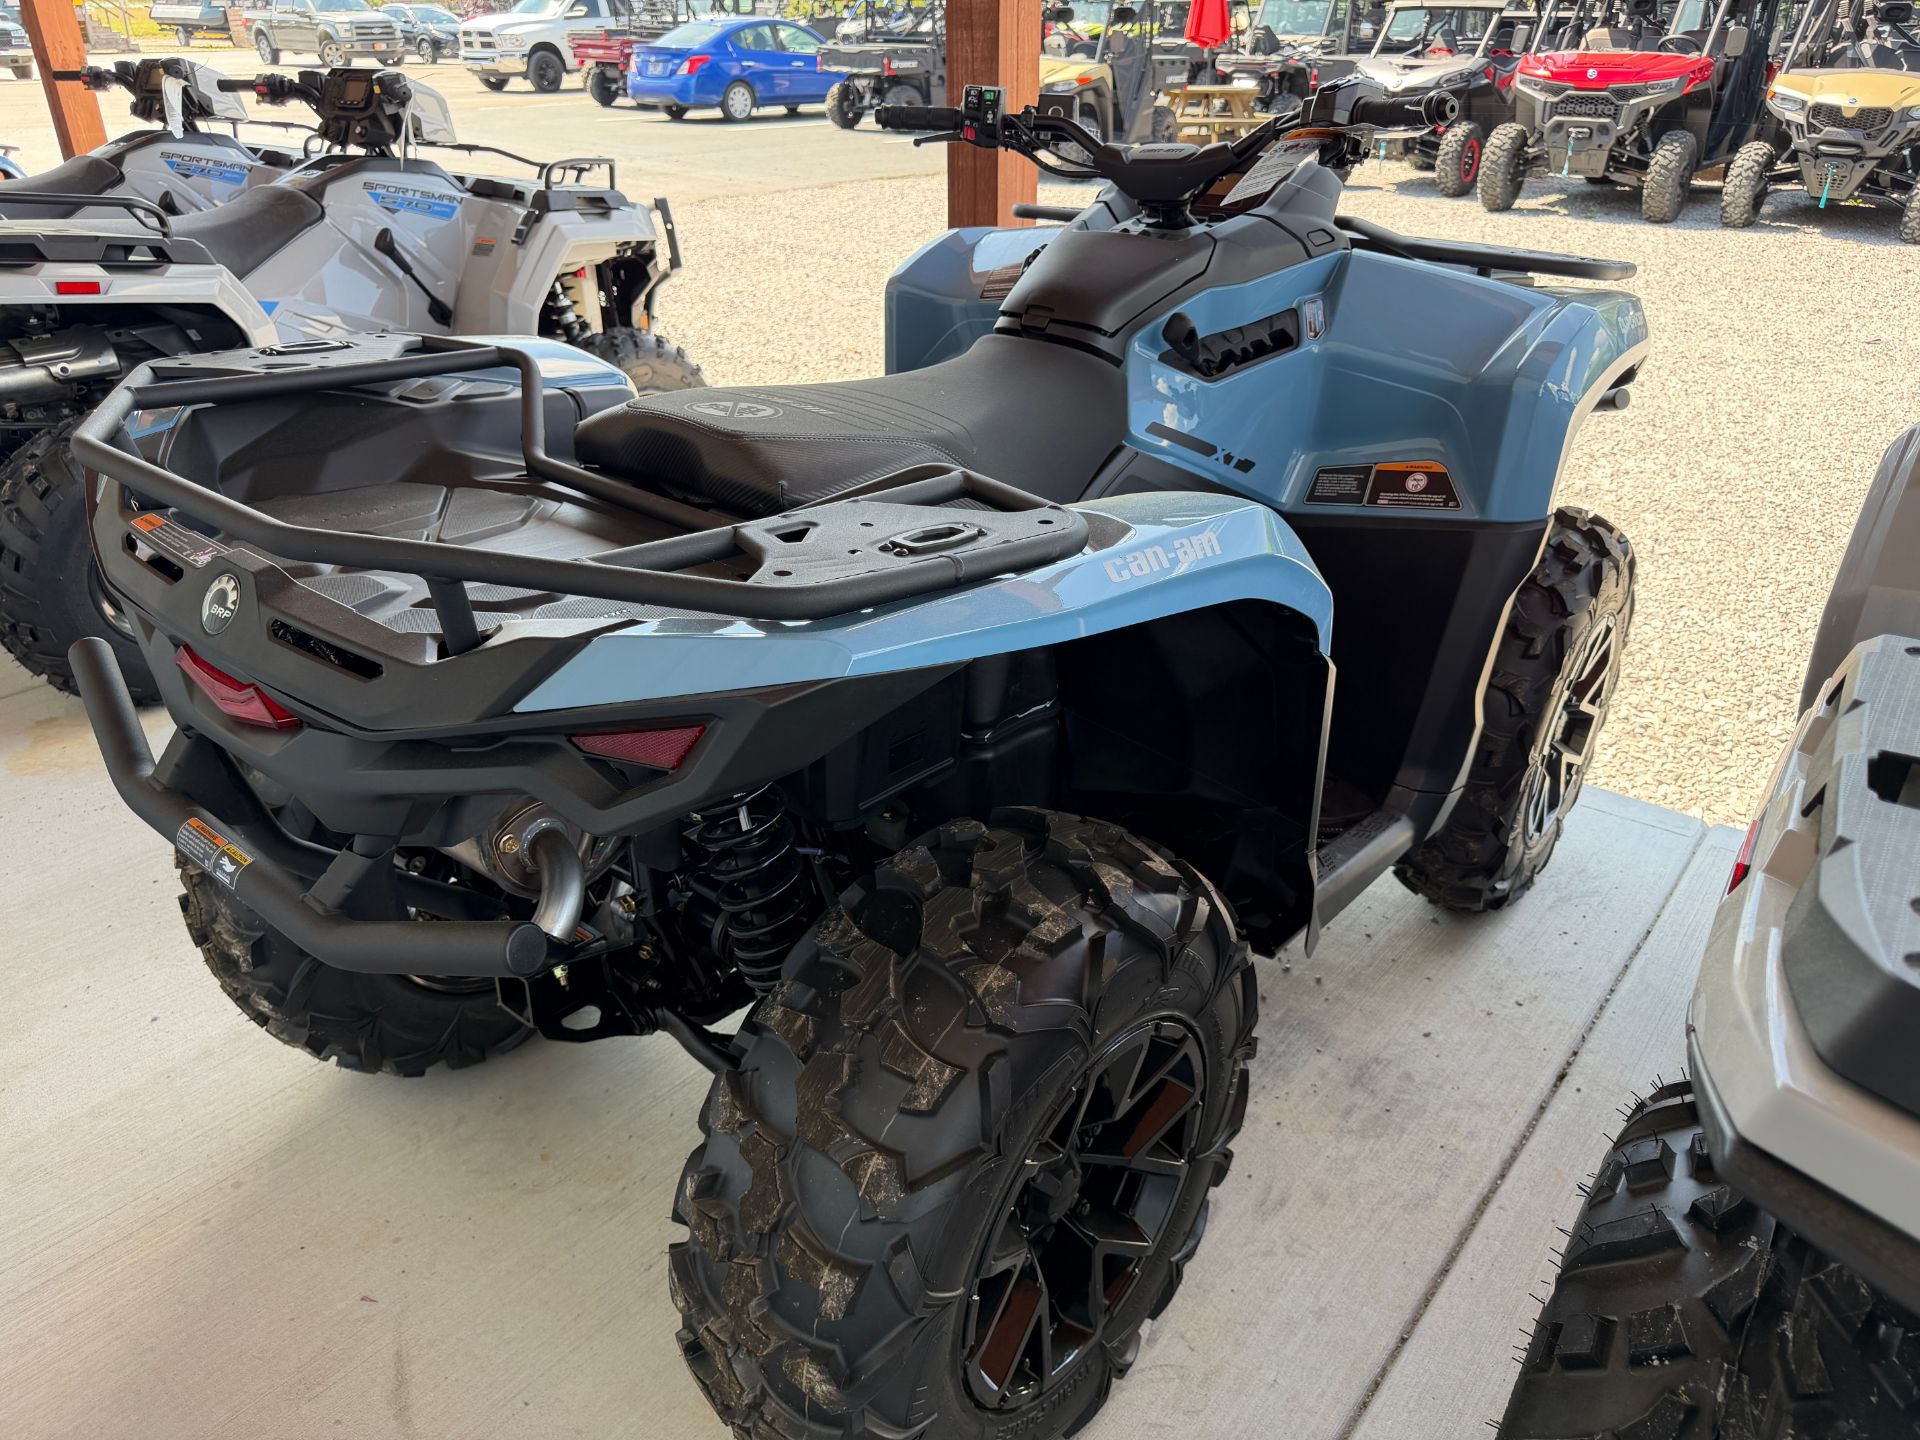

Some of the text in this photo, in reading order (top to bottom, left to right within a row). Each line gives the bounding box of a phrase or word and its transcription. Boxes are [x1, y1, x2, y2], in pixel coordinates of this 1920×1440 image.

[160, 151, 253, 172] SPORTSMAN
[362, 181, 463, 205] SPORTSMAN
[380, 195, 433, 211] 570
[1103, 532, 1222, 583] can-am
[210, 603, 232, 619] BRP
[230, 847, 249, 864] CAUTION
